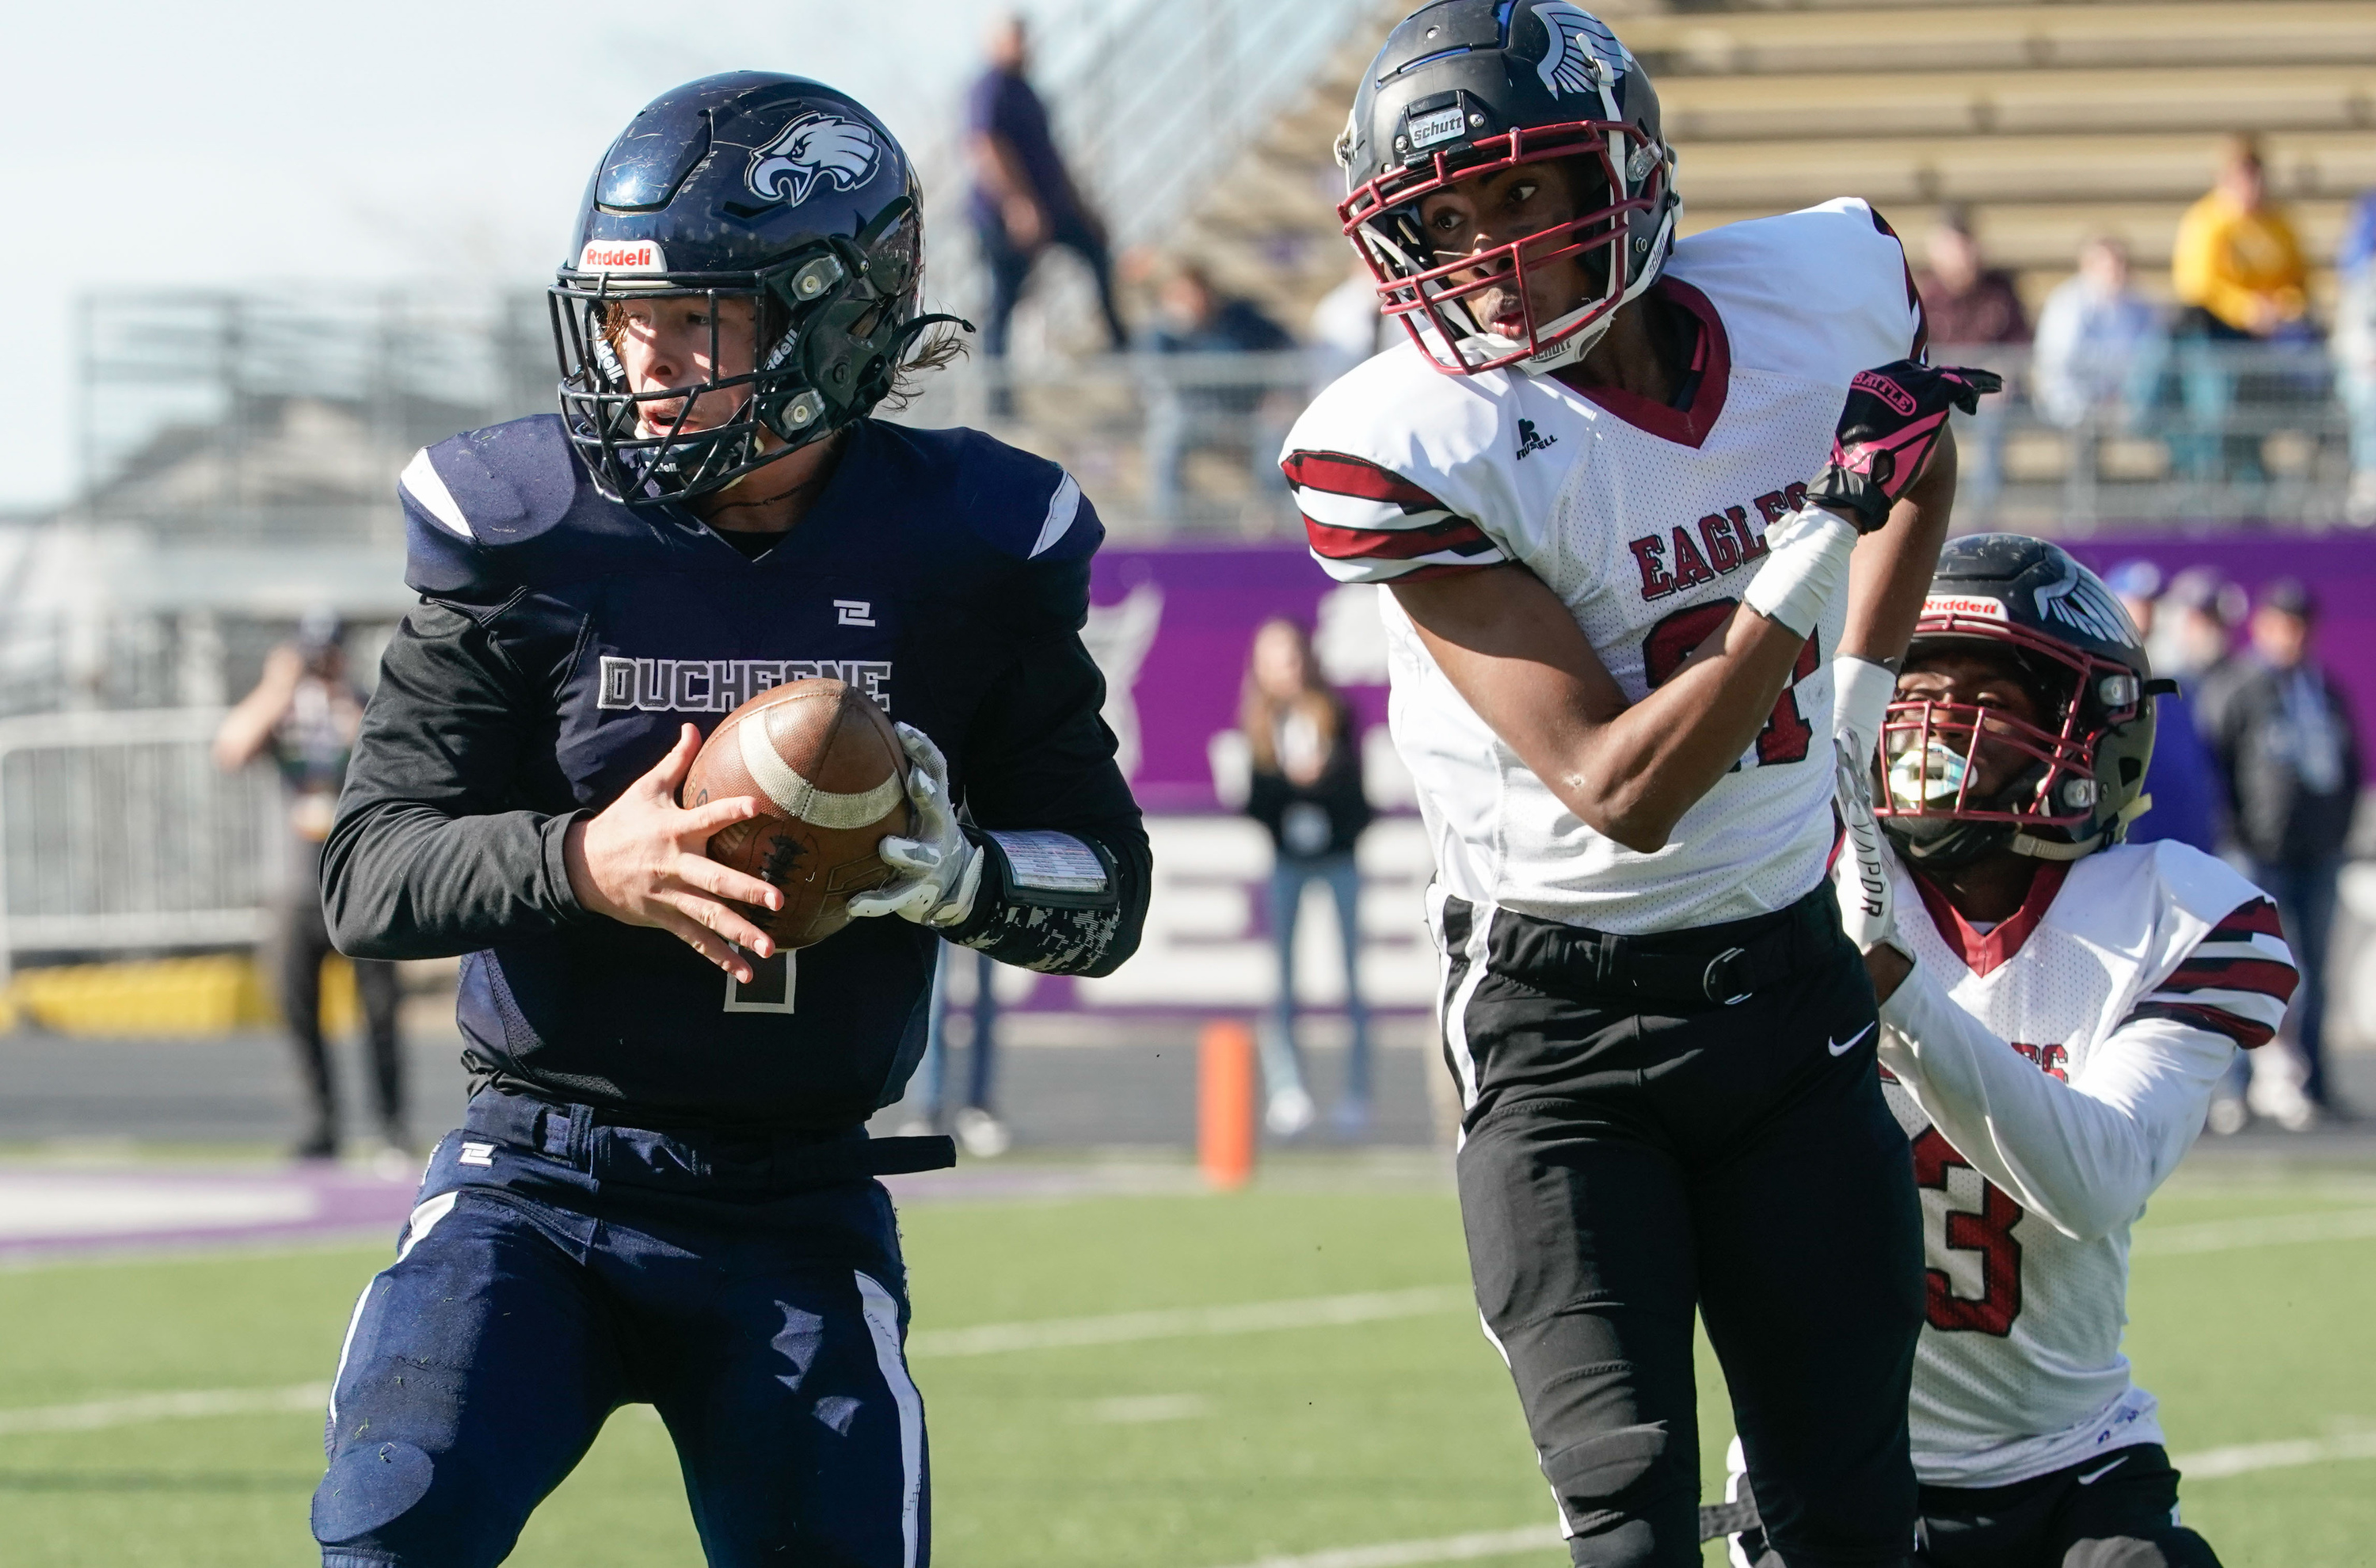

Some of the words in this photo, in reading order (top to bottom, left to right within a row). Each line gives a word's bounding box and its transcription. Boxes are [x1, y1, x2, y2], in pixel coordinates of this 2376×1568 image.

[1413, 116, 1462, 141] schutt
[587, 248, 651, 266] Riddell
[1853, 371, 1911, 410] BATTLE
[1921, 599, 1998, 615] Riddell
